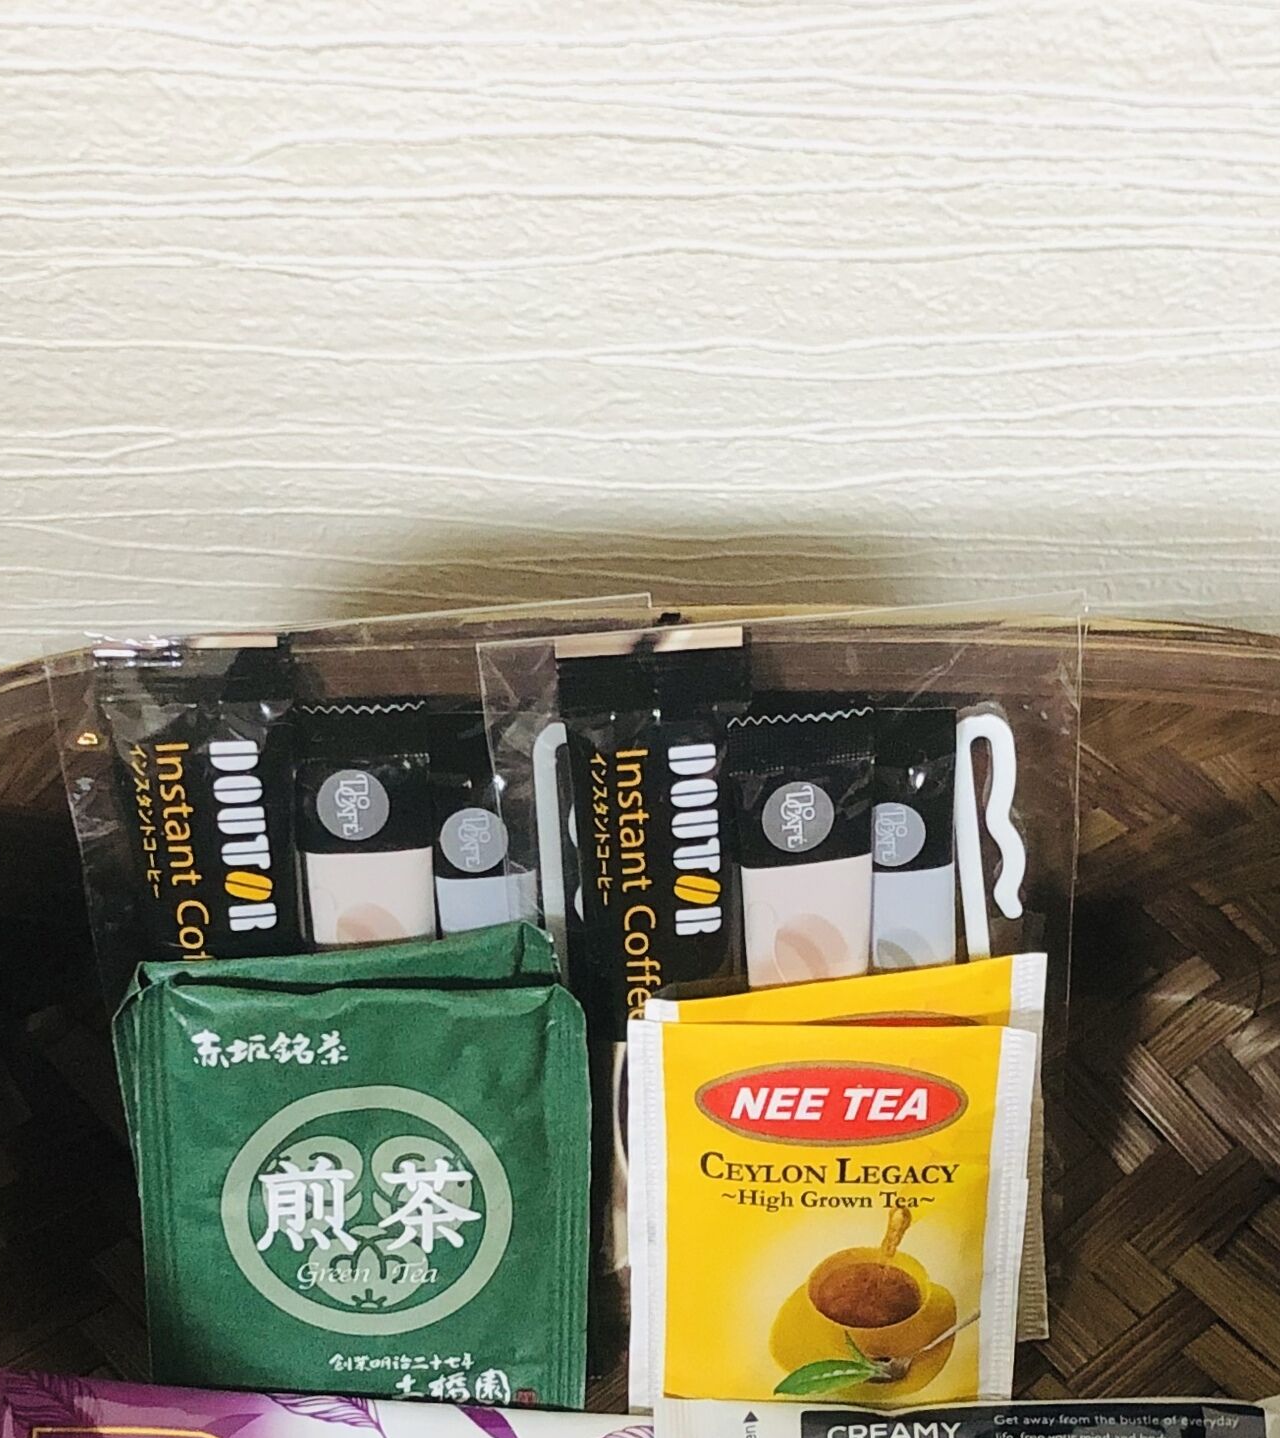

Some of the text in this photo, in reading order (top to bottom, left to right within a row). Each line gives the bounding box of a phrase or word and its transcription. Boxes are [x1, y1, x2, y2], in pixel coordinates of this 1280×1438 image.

[129, 744, 162, 899] インスタントコーヒー
[155, 743, 202, 886] Instant
[590, 752, 613, 906] インスタントコーヒー
[615, 749, 653, 893] Instant
[730, 1087, 929, 1122] NEE TEA
[700, 1151, 960, 1185] CEYLON LEGACY
[801, 1191, 873, 1208] Grown
[256, 1155, 482, 1254] 煎茶
[296, 1262, 439, 1290] Green Tea
[993, 1414, 1239, 1429] Get away from the bustle of everyday
